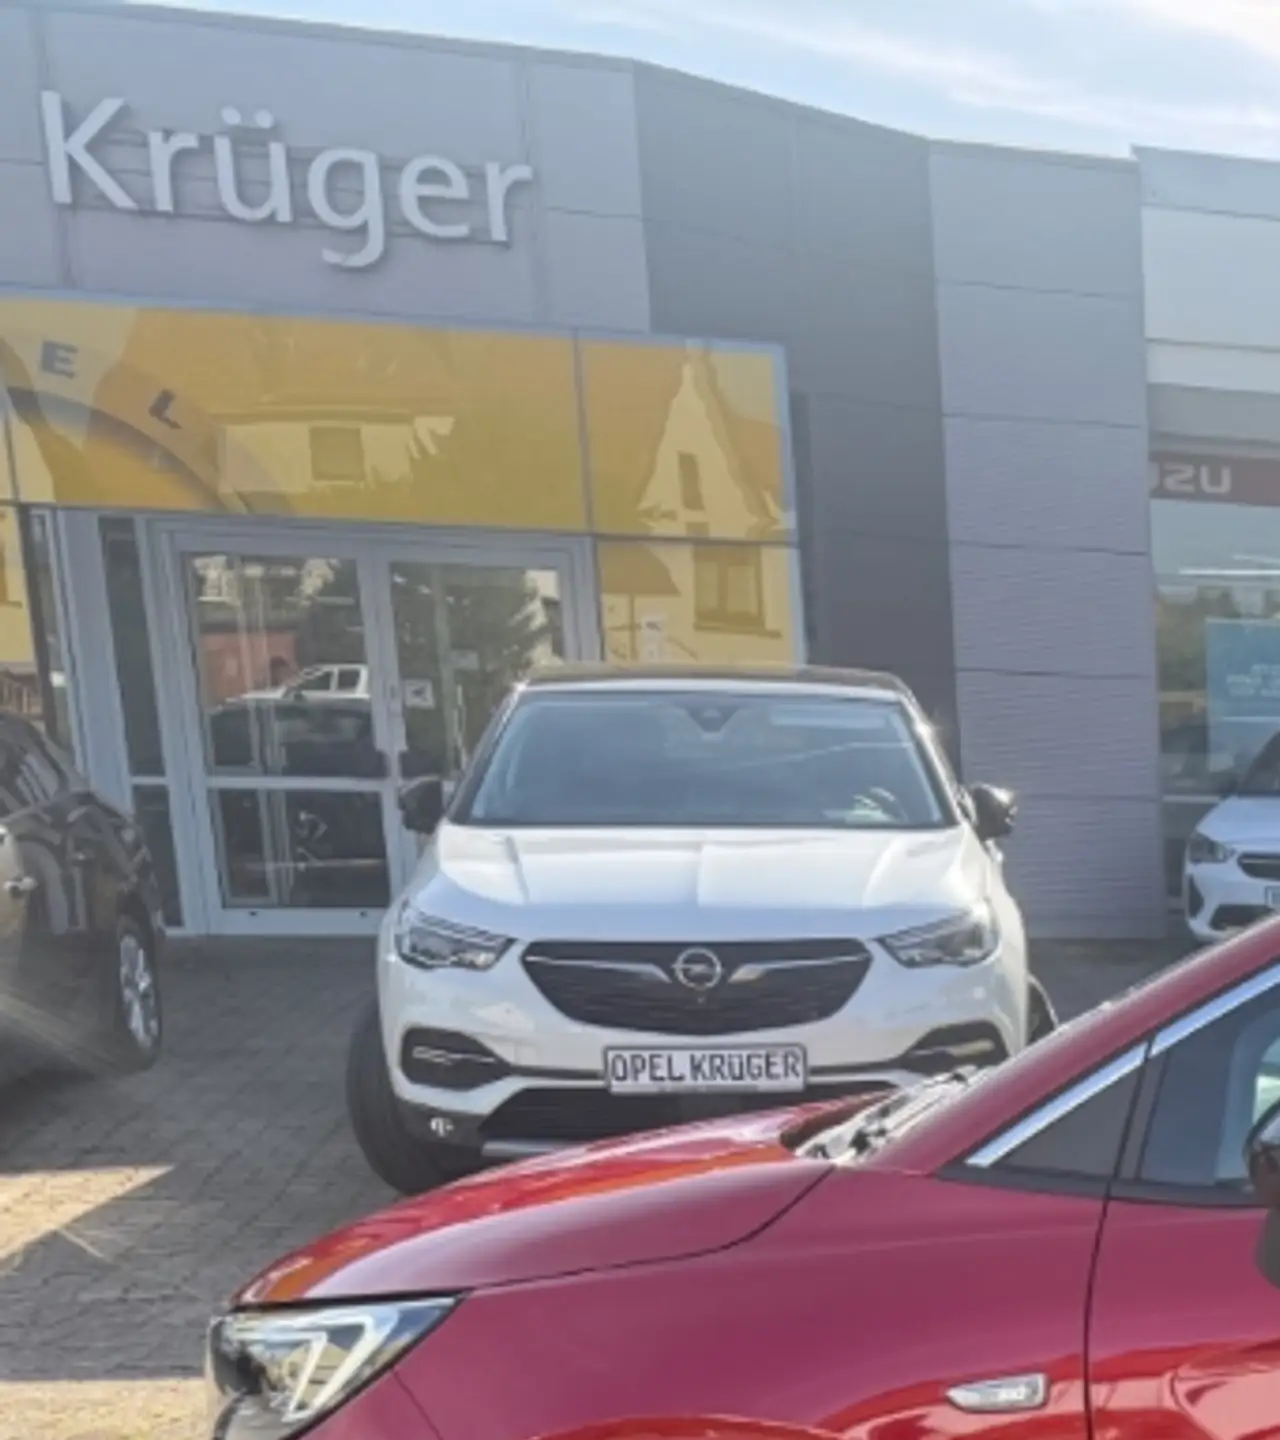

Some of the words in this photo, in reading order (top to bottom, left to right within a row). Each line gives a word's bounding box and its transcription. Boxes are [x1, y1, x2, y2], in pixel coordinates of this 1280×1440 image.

[41, 91, 533, 267] Krüger
[1148, 461, 1231, 494] ZU
[611, 1053, 685, 1082] OPEL
[689, 1051, 801, 1082] KRÜGER
